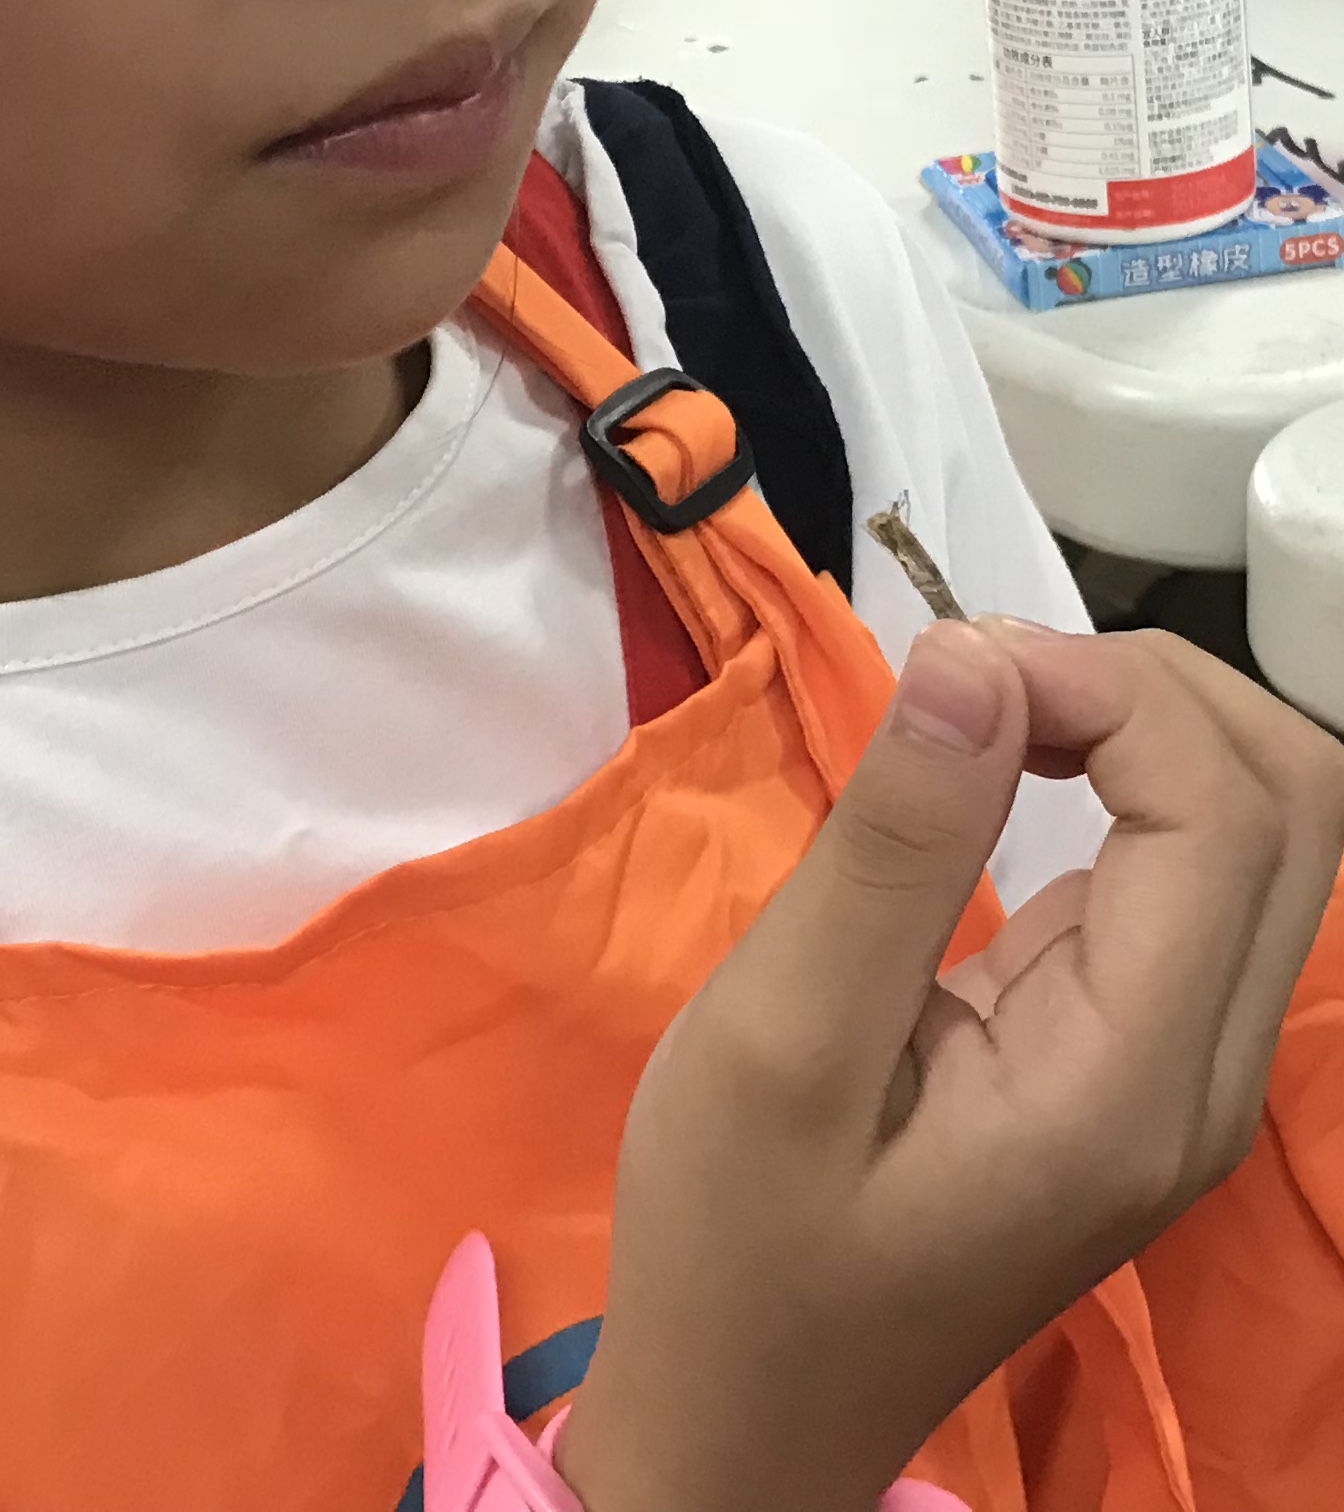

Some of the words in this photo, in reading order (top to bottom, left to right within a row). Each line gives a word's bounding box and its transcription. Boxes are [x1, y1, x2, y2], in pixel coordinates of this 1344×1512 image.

[1120, 243, 1250, 288] 造型橡皮
[1284, 236, 1340, 262] 5PCS
